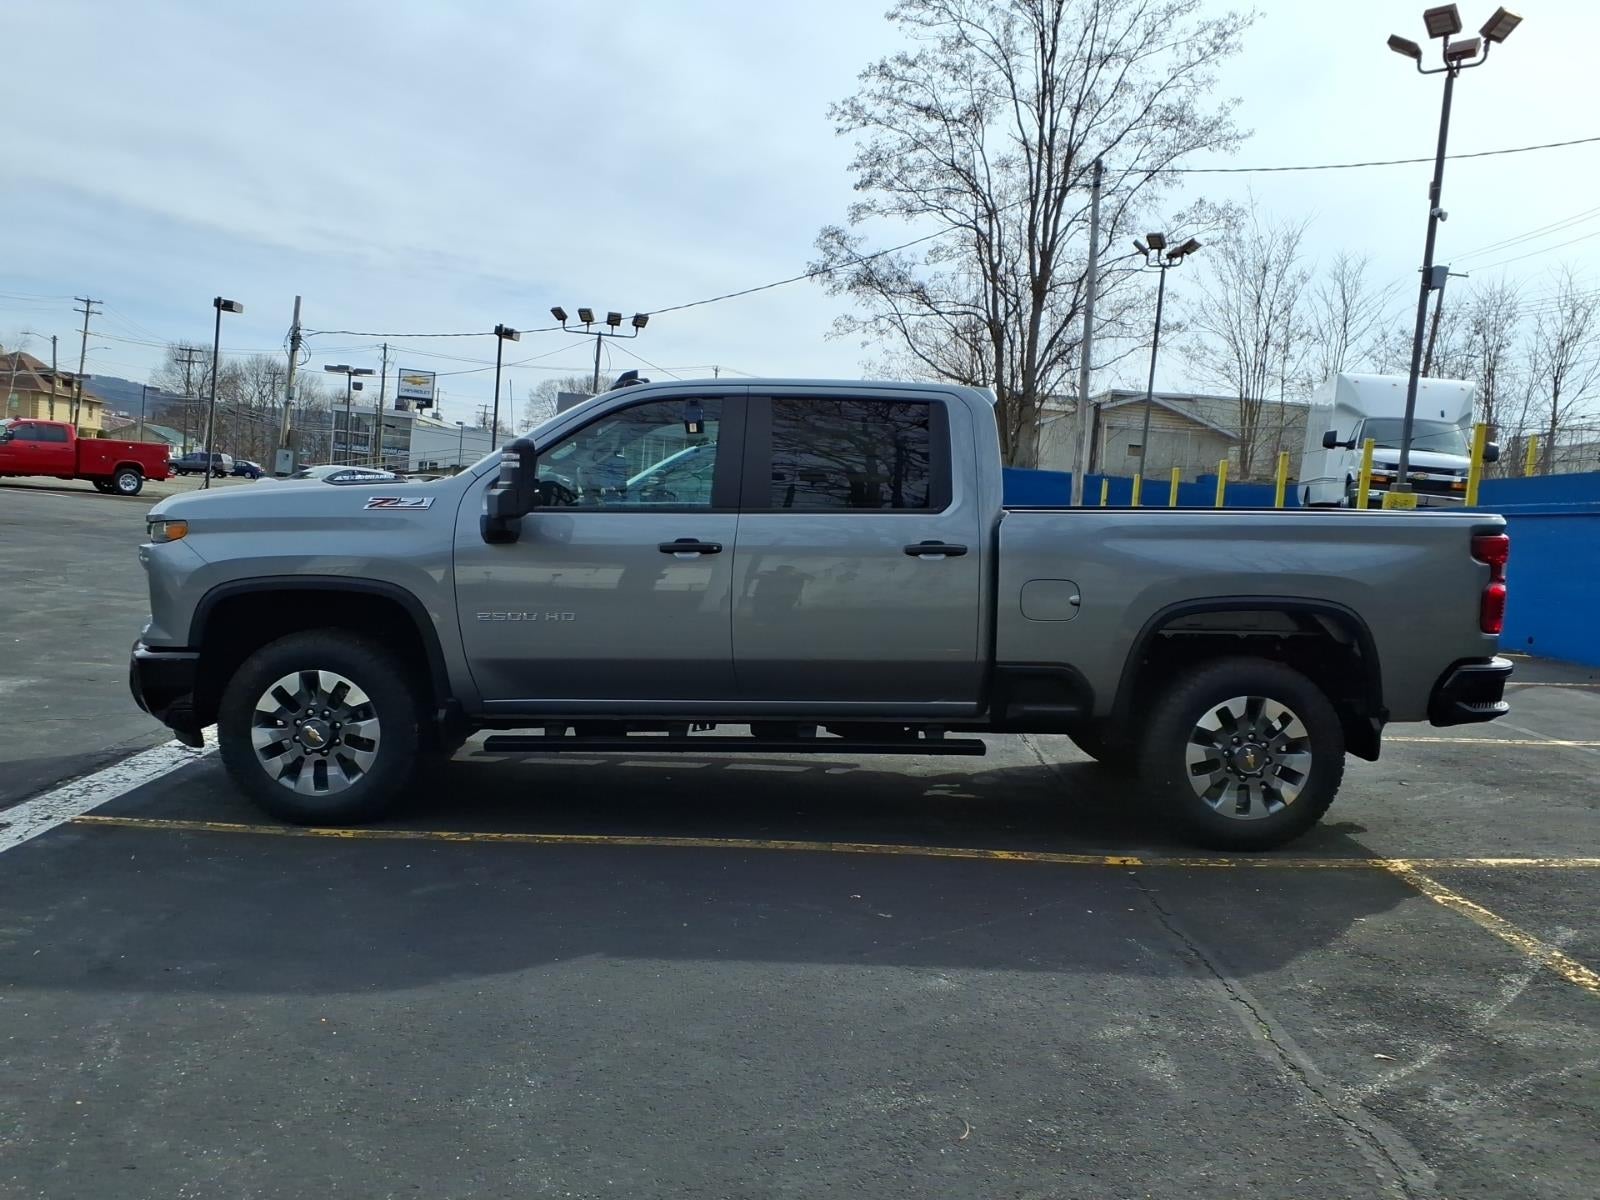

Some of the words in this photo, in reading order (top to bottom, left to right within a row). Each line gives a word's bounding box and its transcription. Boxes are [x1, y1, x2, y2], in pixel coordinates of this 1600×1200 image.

[364, 496, 436, 510] Z71
[476, 612, 538, 622] 2500
[545, 612, 577, 622] HD
